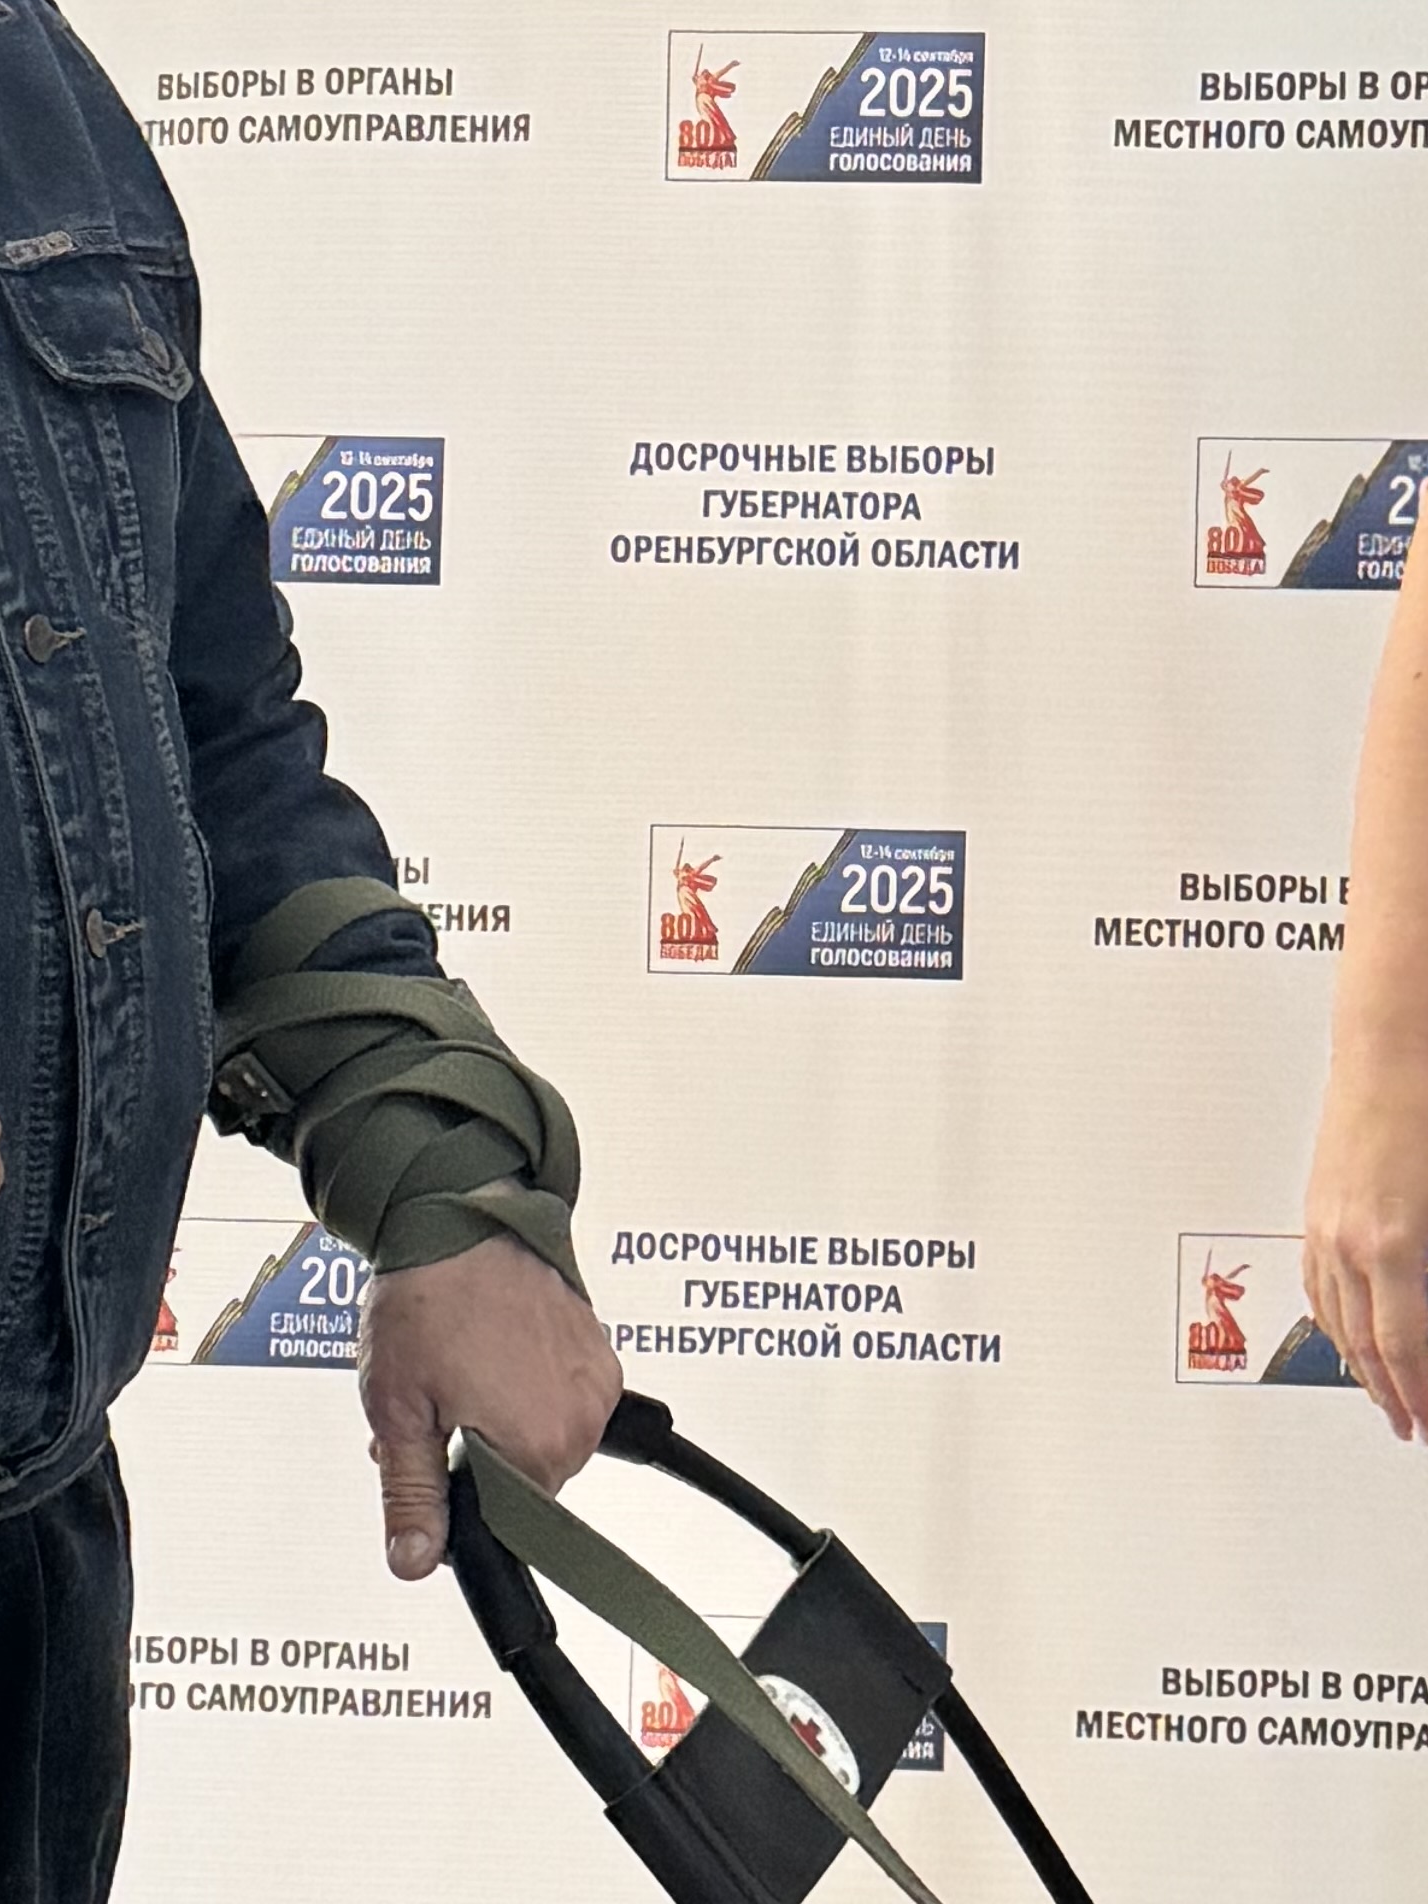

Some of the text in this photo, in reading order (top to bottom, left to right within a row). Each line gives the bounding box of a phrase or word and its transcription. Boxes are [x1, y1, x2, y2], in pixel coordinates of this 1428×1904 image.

[157, 67, 453, 101] ВЫБОРЫ В ОРГАНЫ
[859, 67, 972, 117] 2025
[1200, 71, 1346, 101] ВЫБОРЫ
[1358, 71, 1379, 100] В
[145, 113, 531, 146] ТНОГО САМОУПРАВЛЕНИЯ
[679, 119, 712, 147] 80
[830, 123, 971, 149] ЕДИНЫЙ ДЕНЬ
[1114, 119, 1285, 150] МЕСТНОГО
[829, 151, 971, 172] голосования
[629, 442, 994, 476] ДОСРОЧНЫЕ ВЫБОРЫ
[321, 470, 433, 521] 2025
[702, 489, 922, 521] ГУБЕРНАТОРА
[380, 529, 431, 551] ДЕНЬ
[610, 531, 1019, 570] ОРЕНБУРГСКОЙ ОБЛАСТИ
[1207, 527, 1243, 552] 80
[291, 553, 431, 574] голосования
[841, 864, 954, 915] 2025
[1180, 872, 1327, 905] ВЫБОРЫ
[811, 919, 952, 945] ЕДИНЫЙ ДЕНЬ
[1094, 917, 1265, 949] МЕСТНОГО
[810, 948, 952, 968] голосования
[611, 1231, 976, 1270] ДОСРОЧНЫЕ ВЫБОРЫ
[684, 1279, 903, 1314] ГУБЕРНАТОРА
[270, 1338, 357, 1358] голосов
[615, 1322, 1001, 1363] РЕНБУРГСКОЙ ОБЛАСТИ
[131, 1635, 409, 1672] БОРЫ В ОРГАНЫ
[1162, 1667, 1310, 1699] ВЫБОРЫ
[1321, 1671, 1342, 1700] В
[186, 1682, 492, 1719] САМОУПРАВЛЕНИЯ
[1076, 1710, 1247, 1745] МЕСТНОГО
